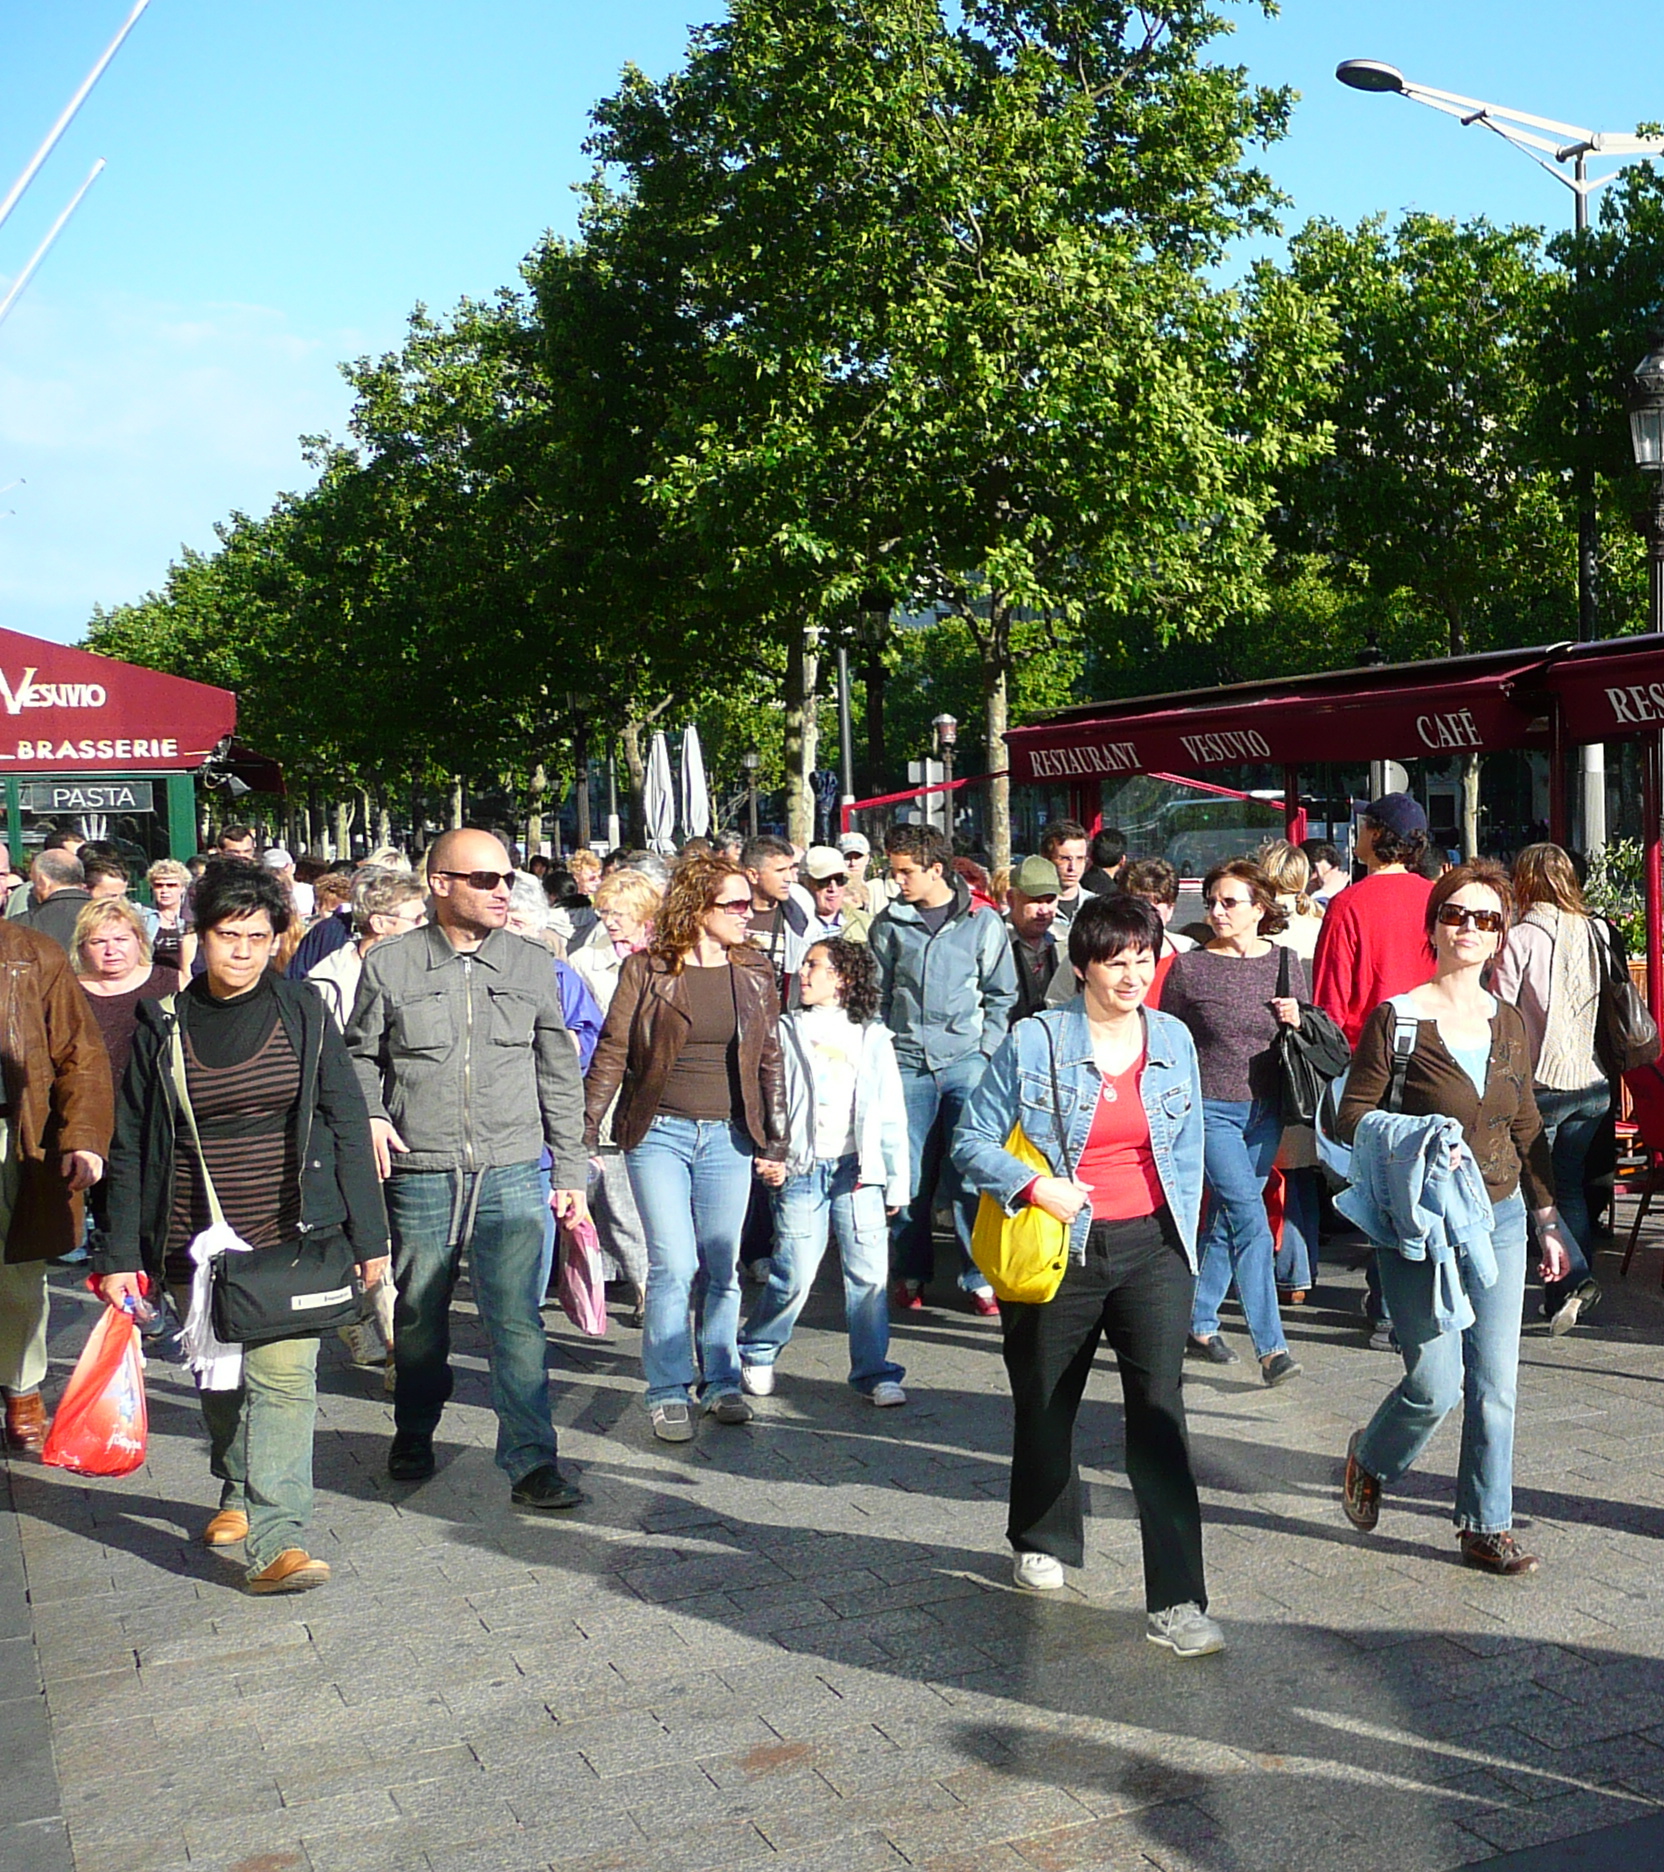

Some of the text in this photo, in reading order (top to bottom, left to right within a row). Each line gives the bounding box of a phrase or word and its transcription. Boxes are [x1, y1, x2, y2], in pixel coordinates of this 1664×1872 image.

[0, 667, 106, 715] VESUVIO
[17, 738, 178, 760] BRASSERIE
[1029, 708, 1483, 778] RESTAURANT VESUVIO CAFÉ
[53, 787, 136, 808] PASTA
